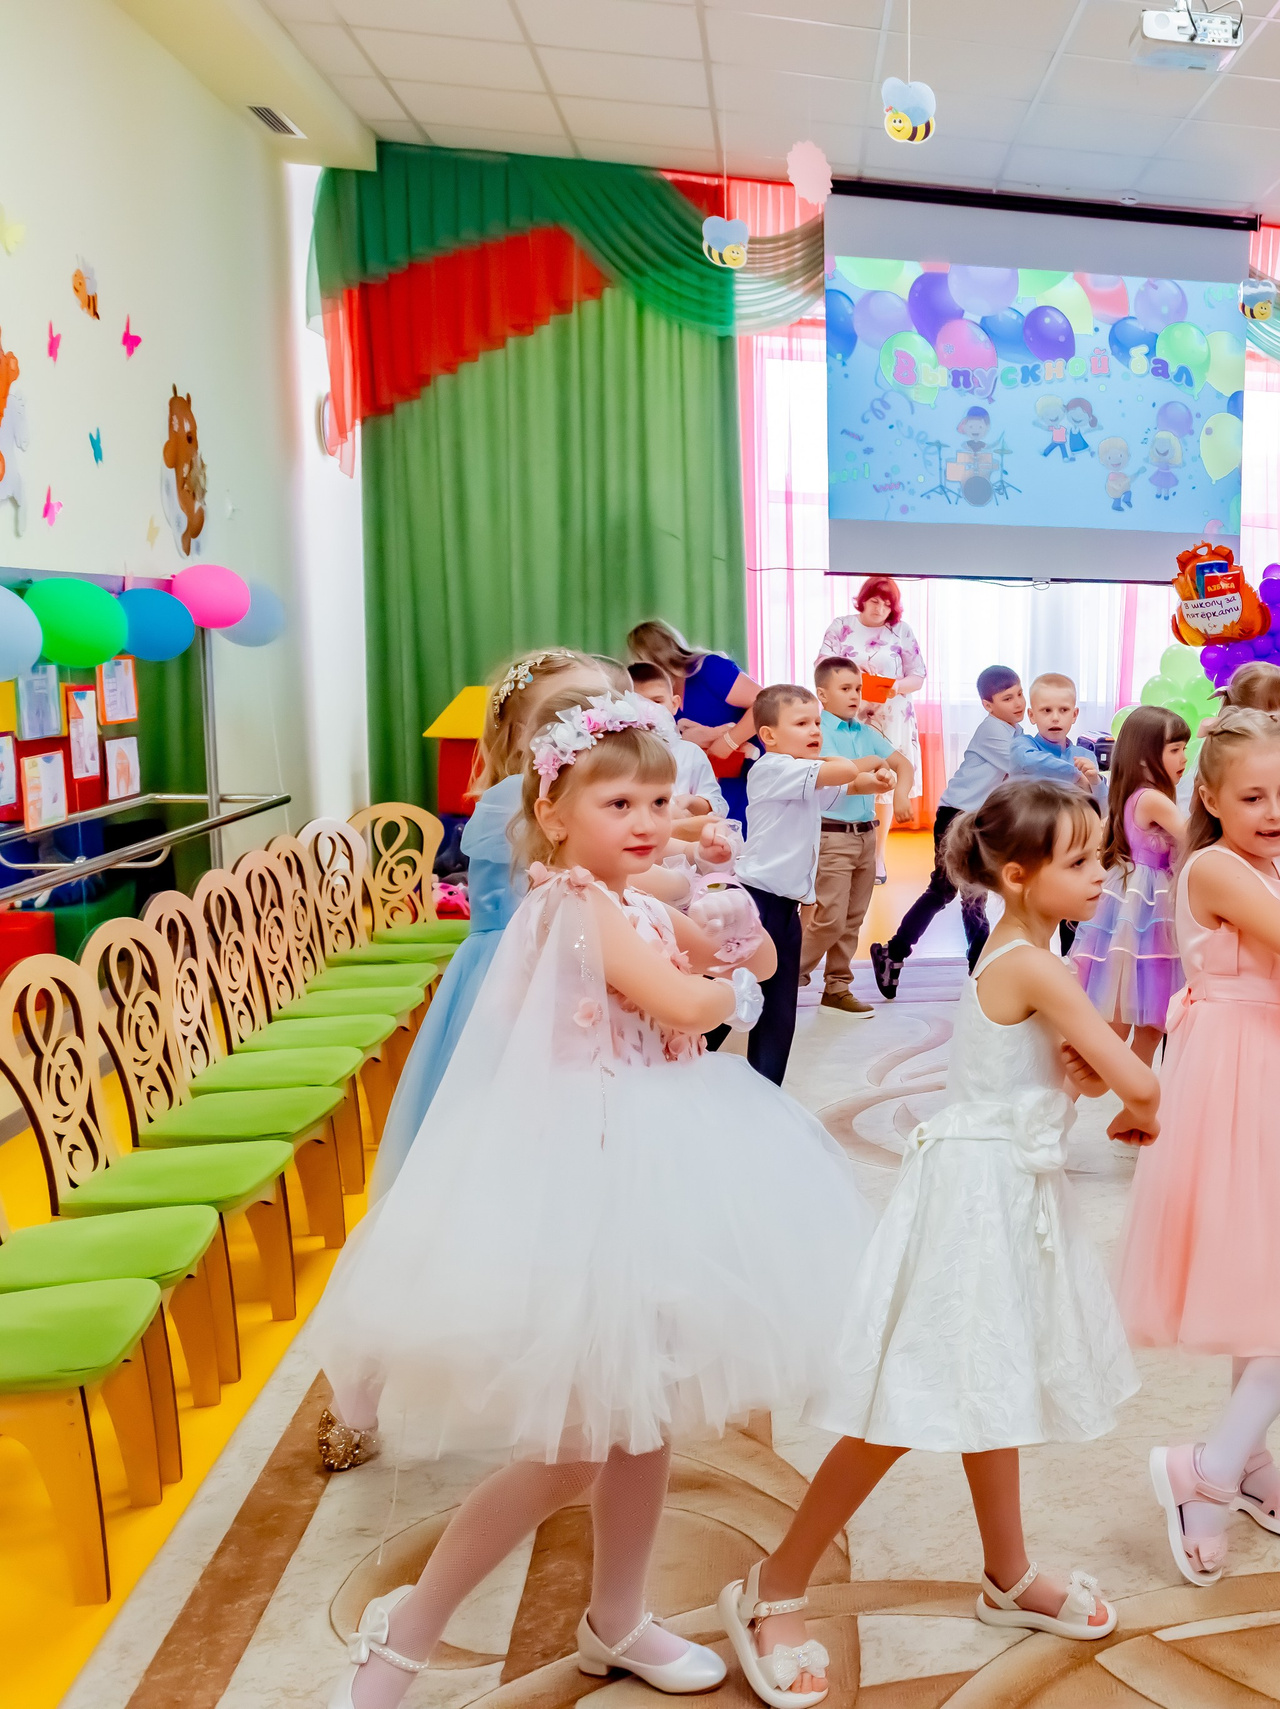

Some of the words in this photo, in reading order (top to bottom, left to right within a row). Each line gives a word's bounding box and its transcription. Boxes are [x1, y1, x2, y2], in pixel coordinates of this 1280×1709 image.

[891, 347, 1111, 398] Выпускной
[1128, 344, 1196, 390] бал
[1191, 600, 1223, 609] школу
[1225, 596, 1236, 604] за
[1186, 606, 1239, 621] пятёрками
